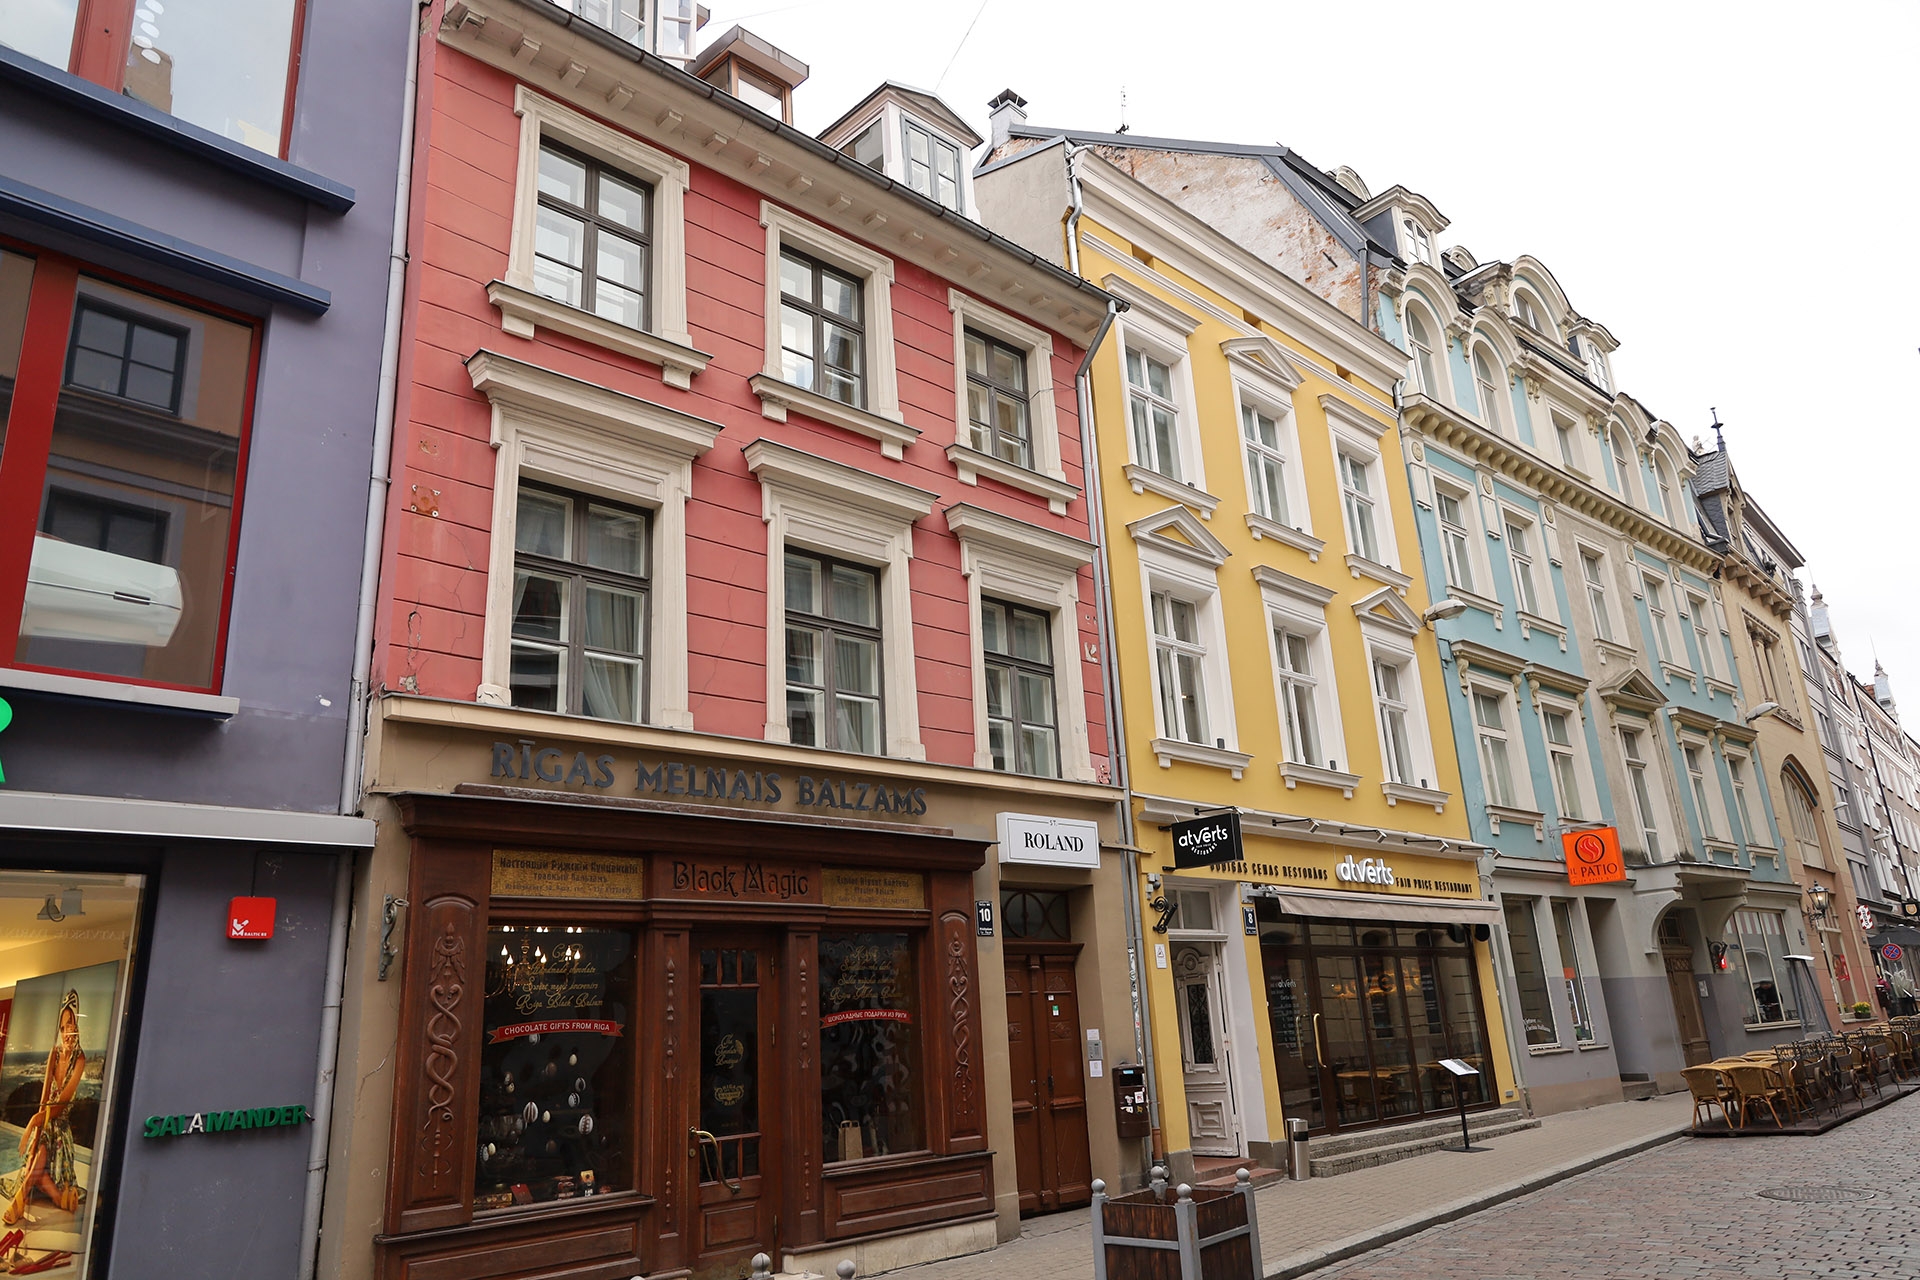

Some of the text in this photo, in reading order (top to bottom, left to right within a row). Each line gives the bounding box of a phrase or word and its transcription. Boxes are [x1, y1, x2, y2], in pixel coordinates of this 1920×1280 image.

[491, 739, 928, 815] RĪGAS MELNAIS BALZAMS
[1024, 832, 1084, 852] ROLAND
[1580, 863, 1618, 877] PATIO
[672, 861, 808, 899] Black Magic
[1395, 877, 1473, 893] FAIR PRICE RESTAURANT
[979, 908, 991, 921] 10
[1248, 912, 1254, 924] 8
[504, 1024, 548, 1035] CHOCOLATE
[594, 1023, 610, 1031] RIGA
[144, 1104, 307, 1138] SALAMANDER
